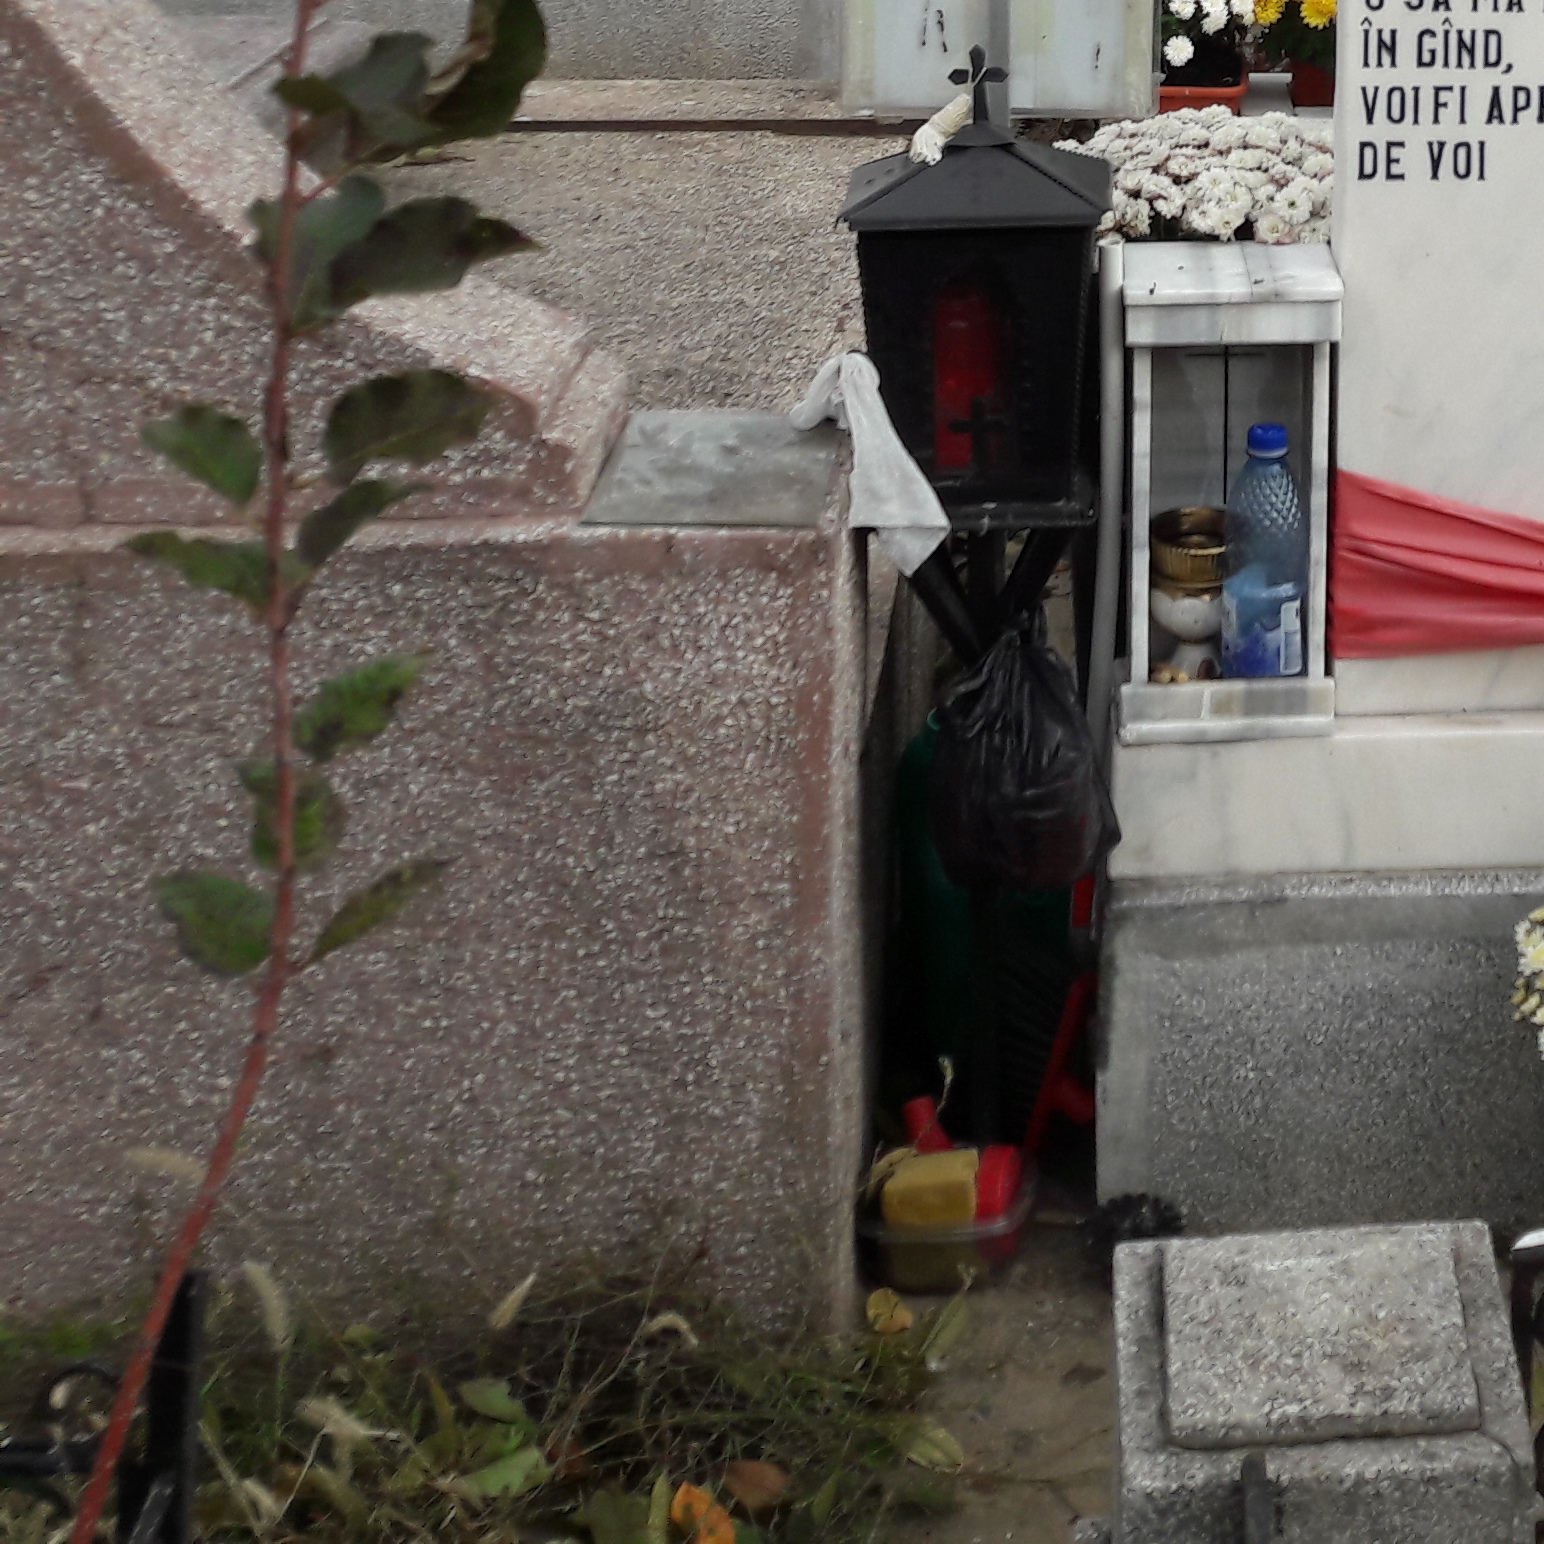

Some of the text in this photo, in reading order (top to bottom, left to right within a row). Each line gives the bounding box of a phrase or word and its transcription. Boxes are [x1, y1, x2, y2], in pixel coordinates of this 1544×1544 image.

[1360, 17, 1514, 75] ÎN GÎND,
[1357, 140, 1487, 181] DE VOI
